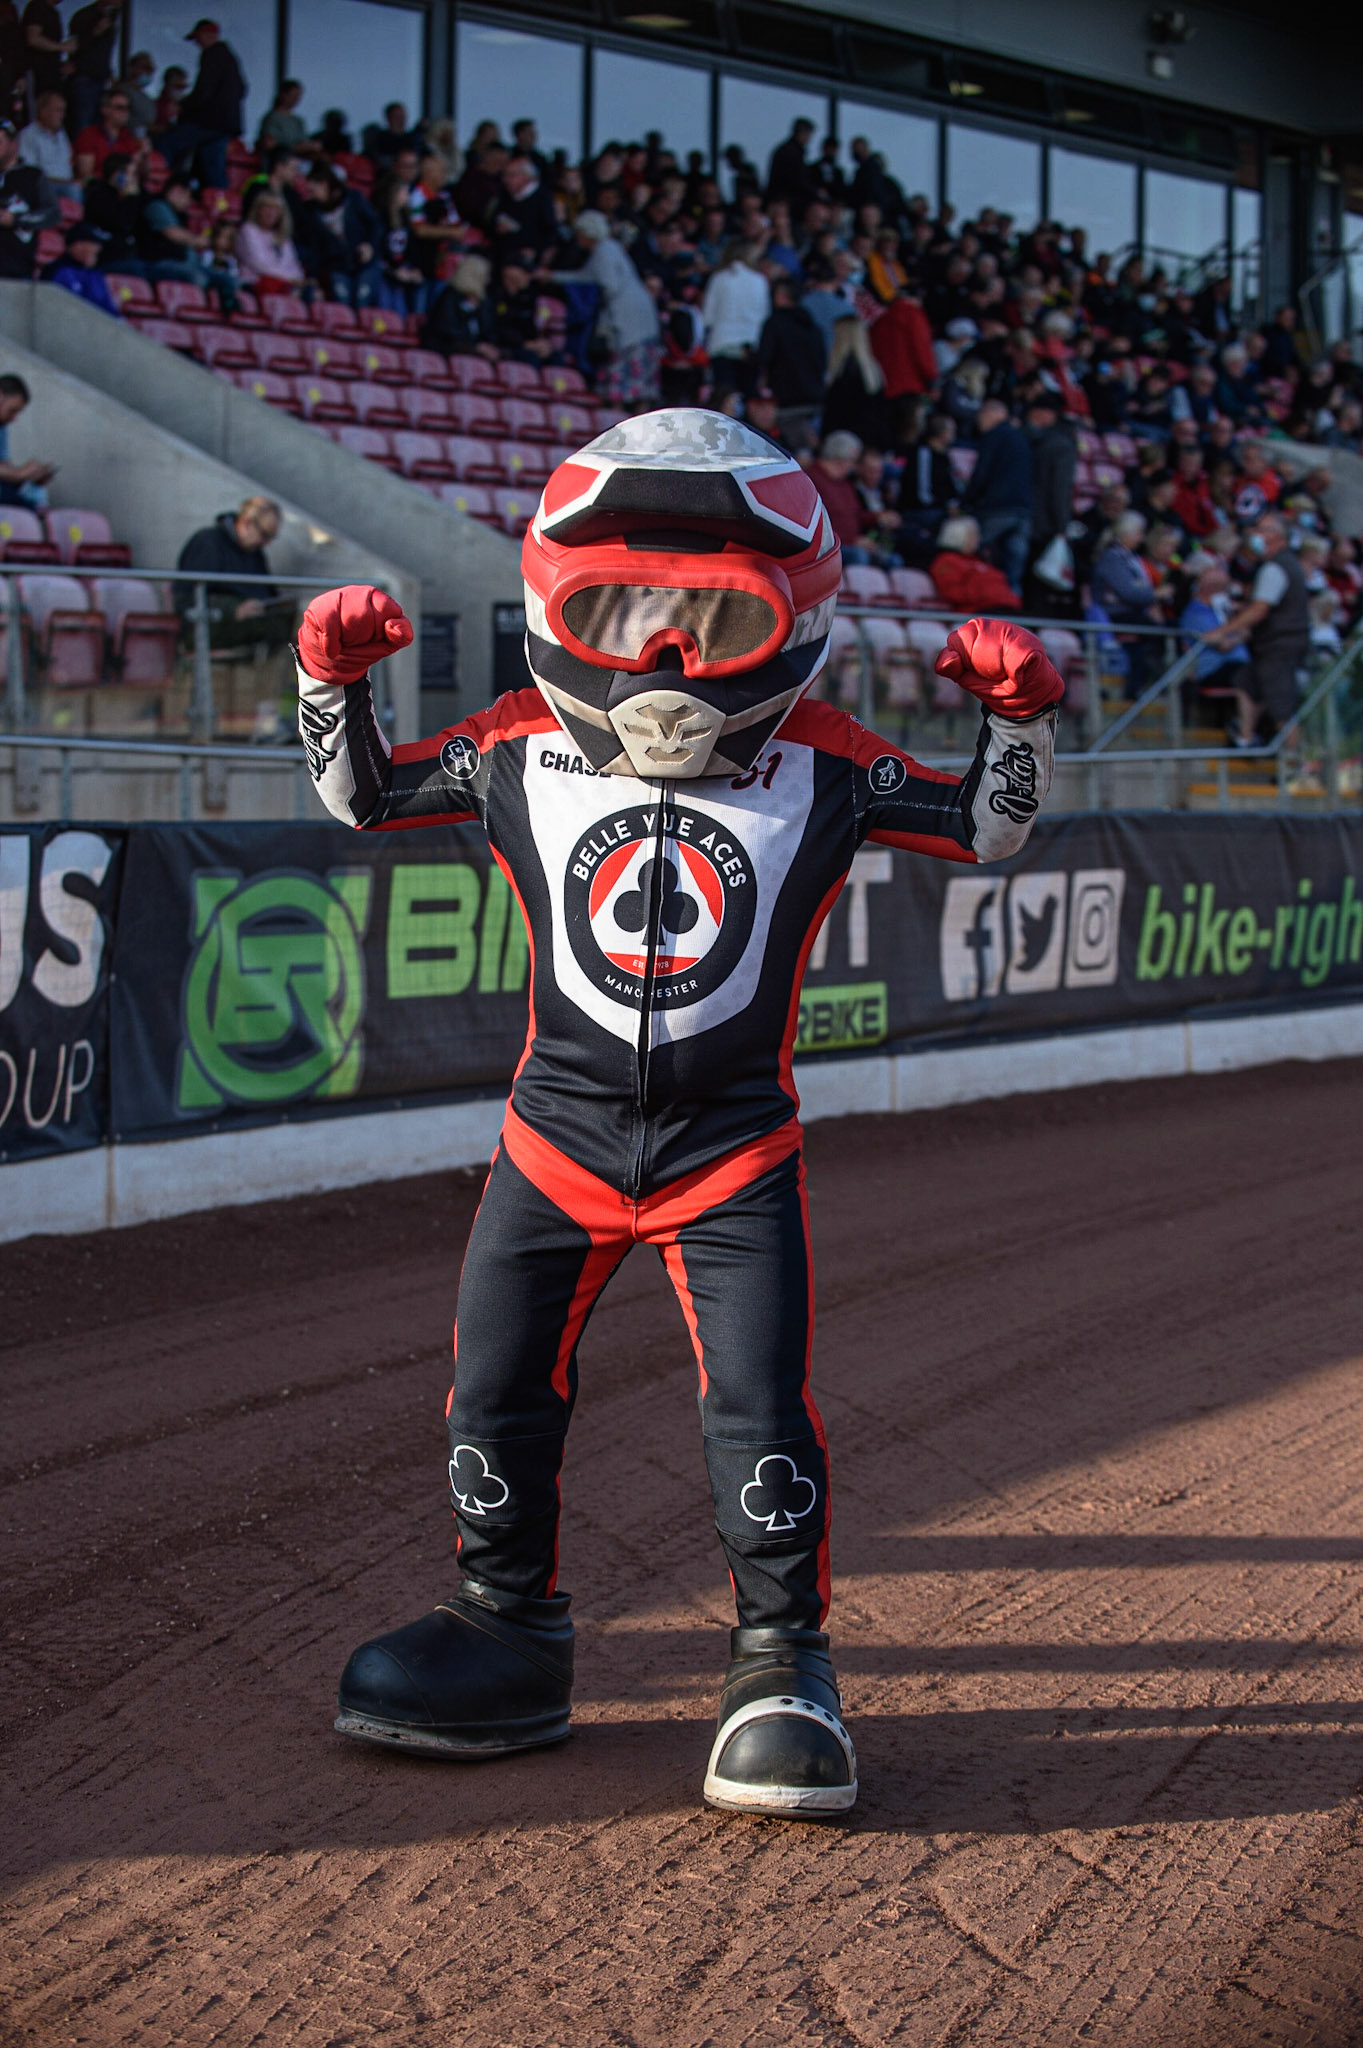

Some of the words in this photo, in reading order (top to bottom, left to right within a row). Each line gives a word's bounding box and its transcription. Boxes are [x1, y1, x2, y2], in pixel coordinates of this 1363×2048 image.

[572, 819, 632, 882] BELLE
[642, 812, 695, 838] VUE
[699, 831, 747, 888] ACES
[604, 974, 699, 998] MANCESTER
